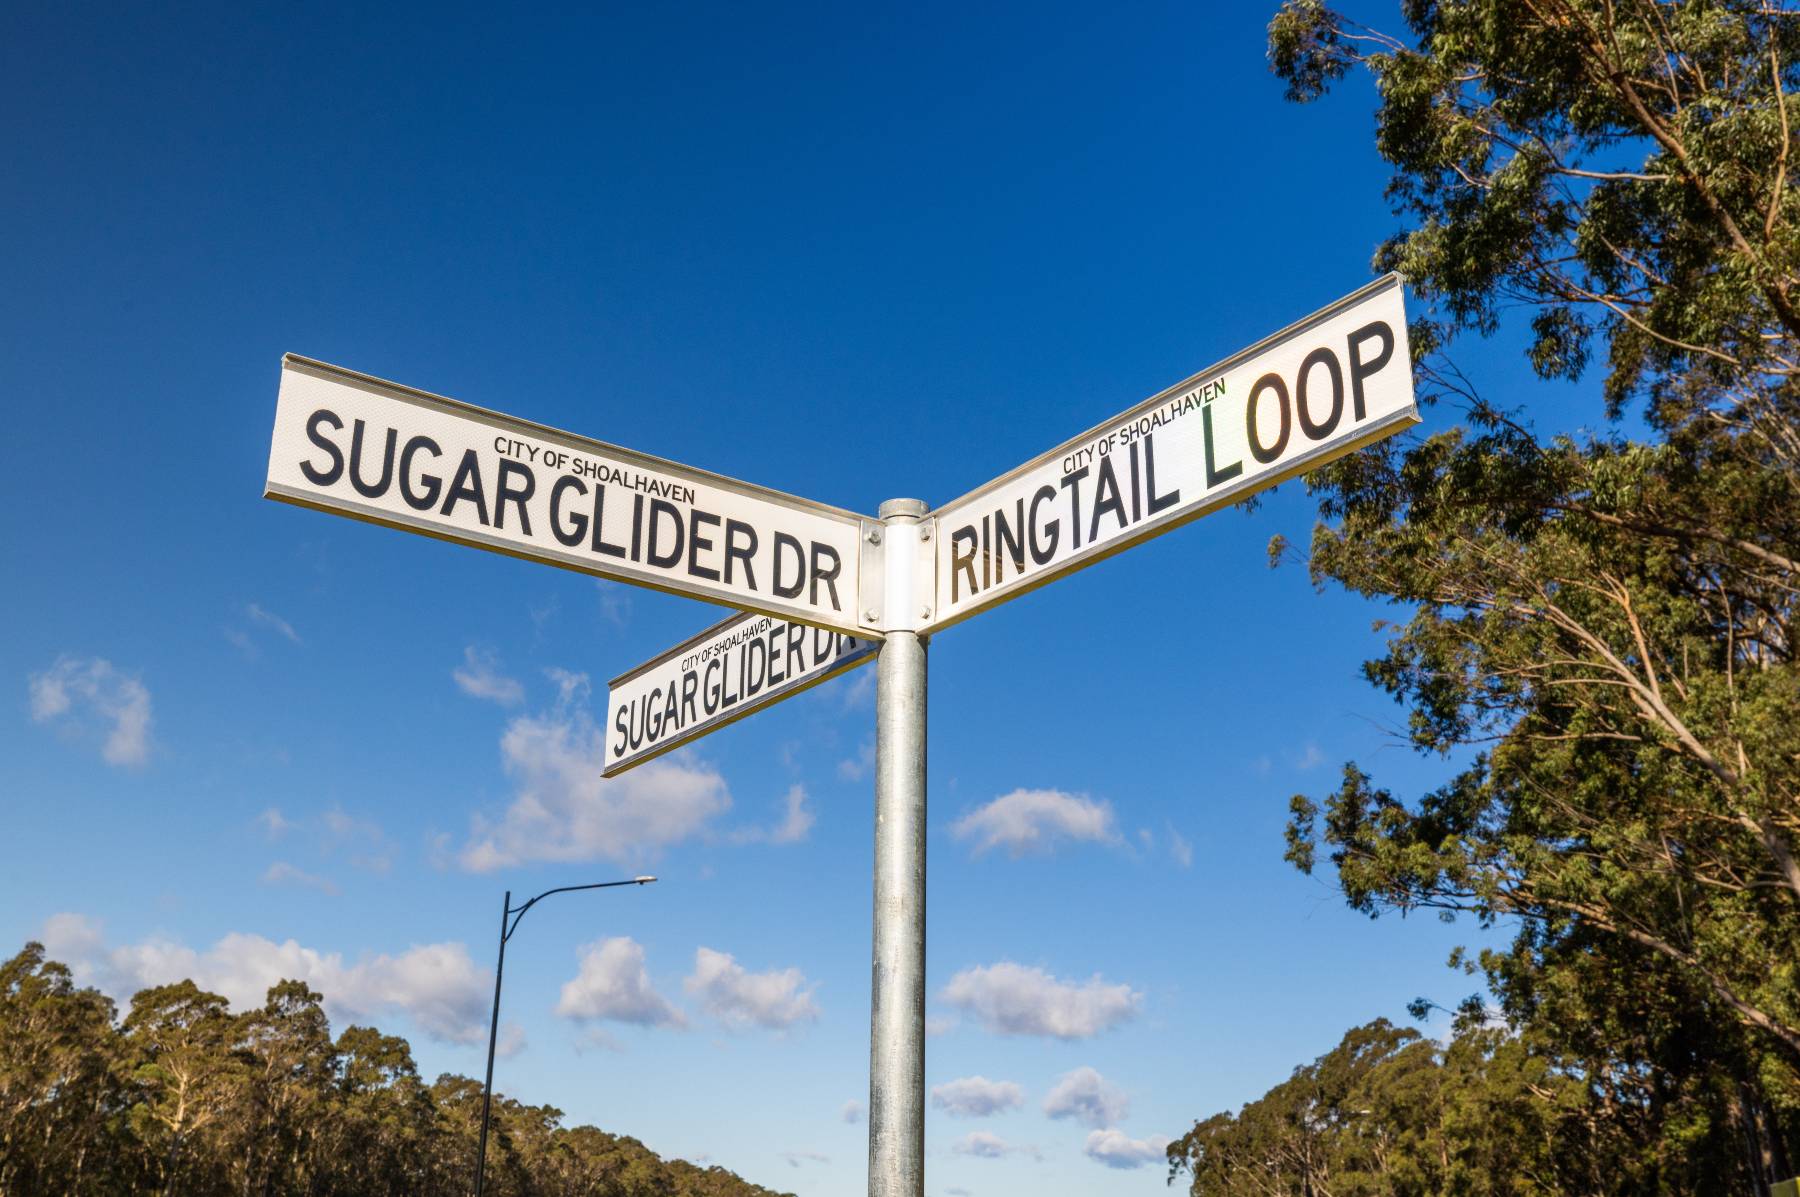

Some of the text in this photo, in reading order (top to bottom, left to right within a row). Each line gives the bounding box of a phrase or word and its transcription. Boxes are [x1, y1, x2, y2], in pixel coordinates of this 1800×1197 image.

[494, 436, 695, 505] CITY OF SHOALHAVEN
[952, 320, 1395, 605] RINGTAIL LOOP
[1063, 377, 1226, 474] CITY OF SHOALHAVEN
[299, 408, 842, 612] SUGAR GLIDER DR
[613, 669, 699, 758] SUGAR
[703, 621, 806, 716] GLIDER
[681, 617, 772, 673] CITY OF SHOALHAVEN
